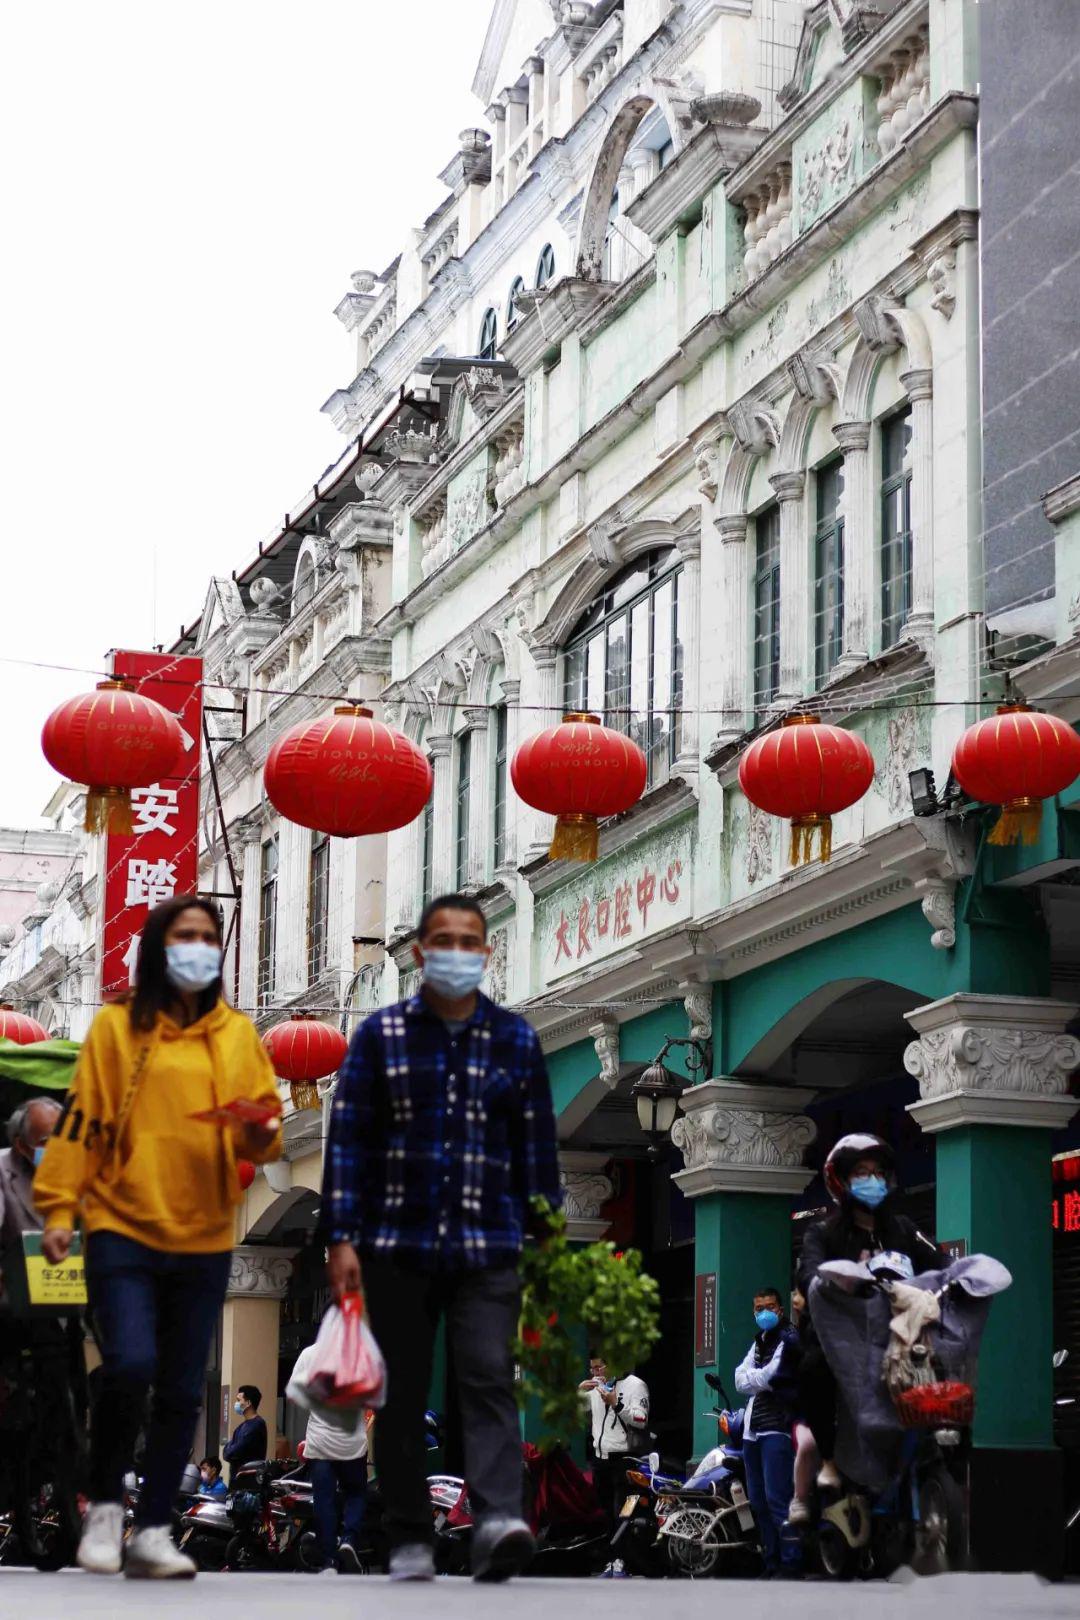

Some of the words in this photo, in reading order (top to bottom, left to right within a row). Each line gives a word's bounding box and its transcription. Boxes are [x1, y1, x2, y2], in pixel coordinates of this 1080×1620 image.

[307, 749, 395, 763] GIORDAN
[553, 858, 683, 966] 大良口腔中心
